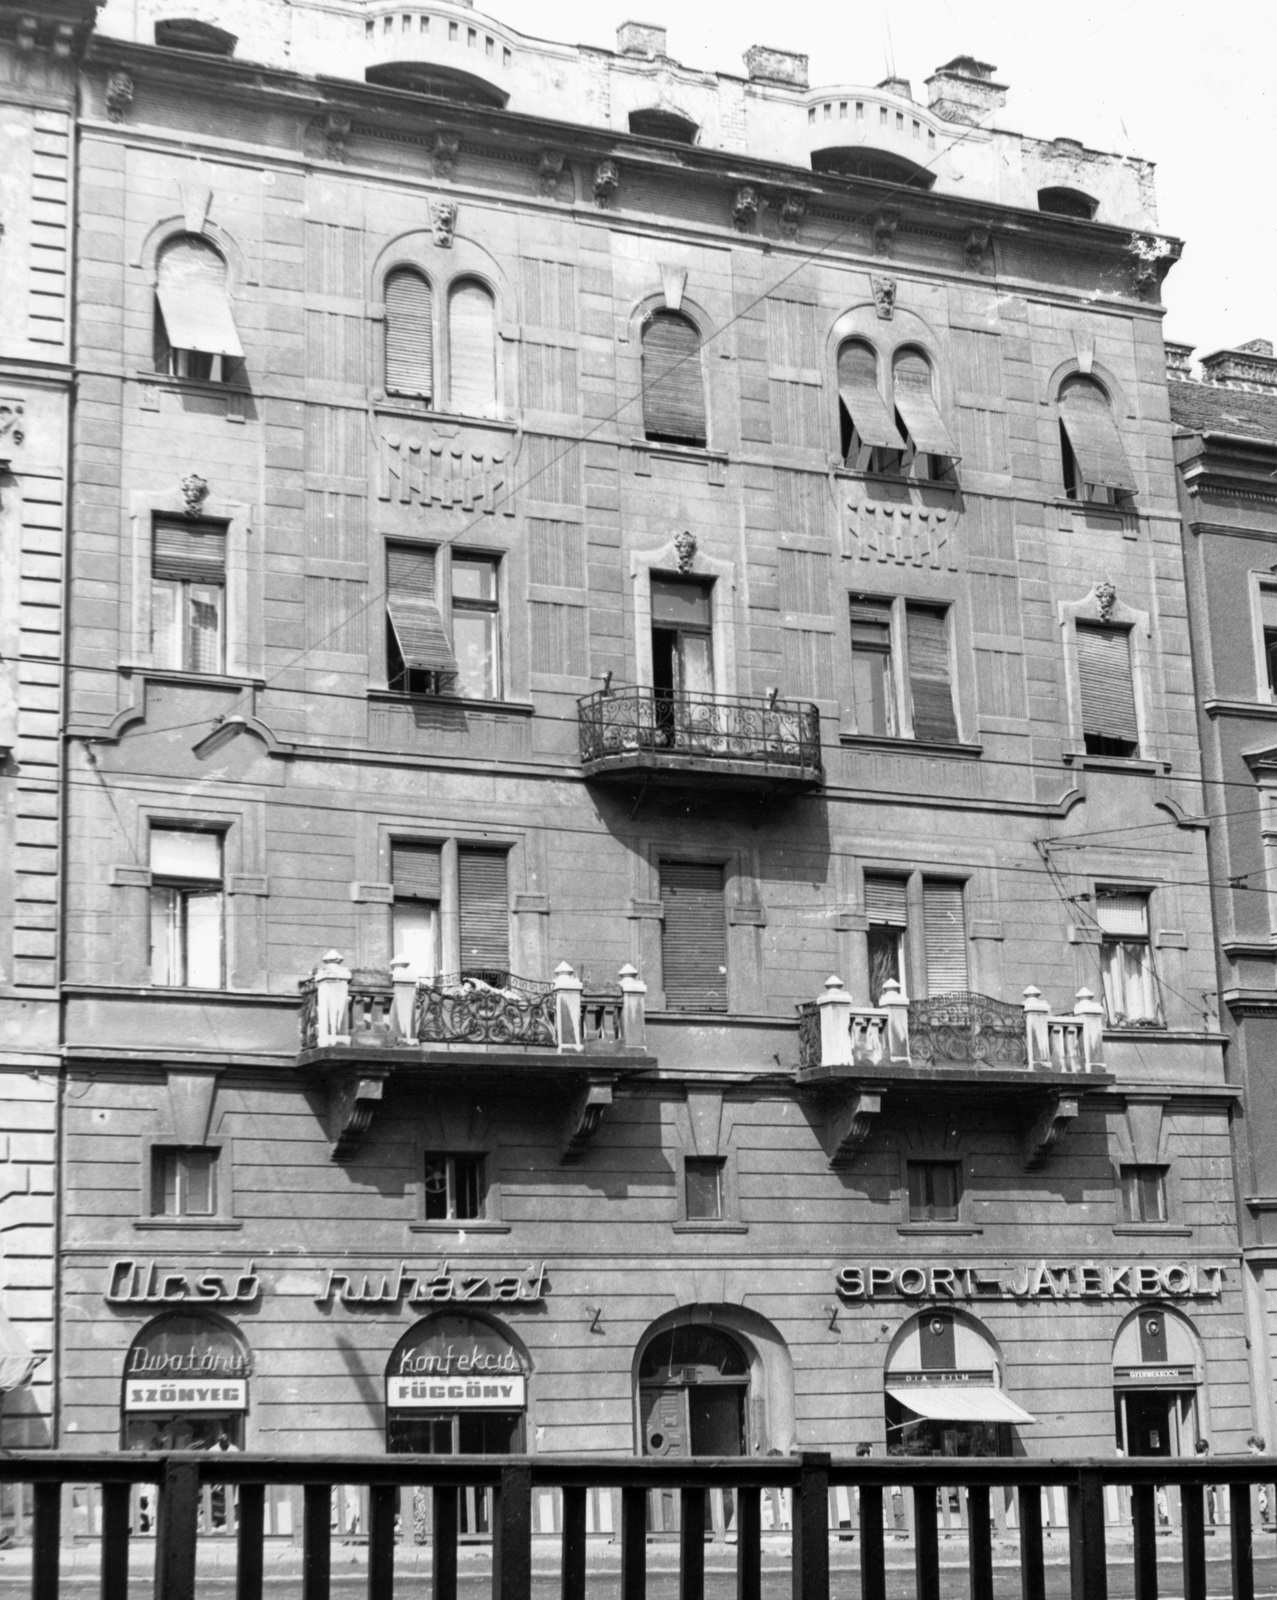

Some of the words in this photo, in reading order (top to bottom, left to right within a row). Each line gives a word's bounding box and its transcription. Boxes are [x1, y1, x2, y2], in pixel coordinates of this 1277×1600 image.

[109, 1259, 260, 1301] Olcsó
[319, 1260, 549, 1301] ruházat
[400, 1344, 516, 1374] Konfekció
[905, 1374, 929, 1382] DIA
[941, 1373, 969, 1381] FILM
[399, 1381, 514, 1399] FÜGGÖNY
